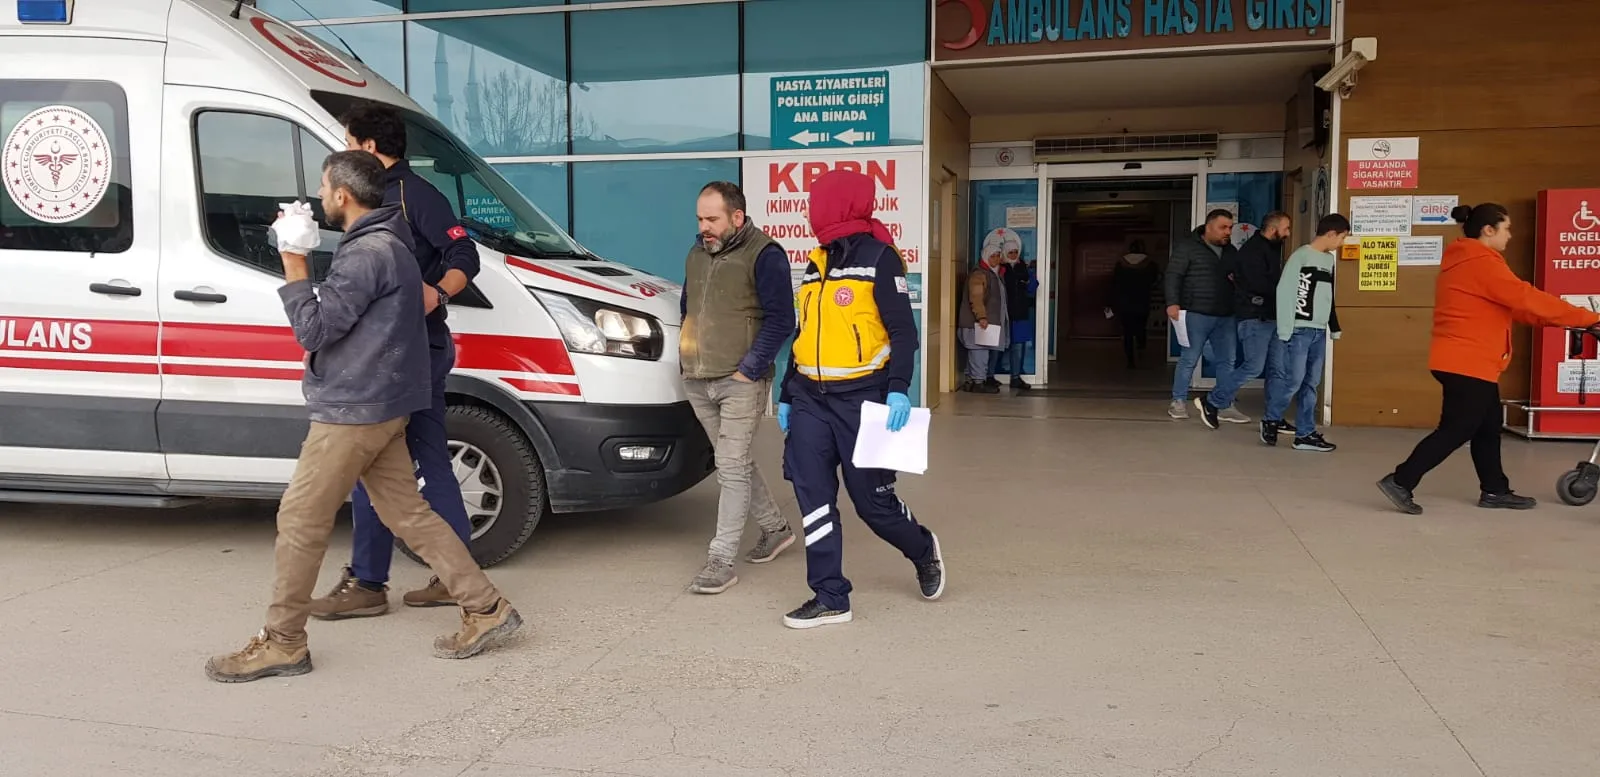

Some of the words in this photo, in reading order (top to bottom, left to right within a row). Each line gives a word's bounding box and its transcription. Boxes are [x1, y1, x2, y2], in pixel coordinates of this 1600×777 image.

[987, 0, 1132, 46] AMBULANS
[1144, 0, 1234, 37] HASTA
[775, 79, 812, 92] HASTA
[815, 75, 886, 90] ZİYARETLERİ
[777, 92, 845, 107] POLİKLİNİK
[847, 89, 884, 107] GİRİŞİ
[793, 111, 819, 123] ANA
[821, 108, 867, 122] BİNADA
[1359, 161, 1371, 169] BU
[1372, 161, 1407, 169] ALANDA
[768, 159, 896, 193] KBN
[1352, 169, 1384, 179] SİGARA
[1385, 169, 1413, 180] İÇMEK
[1361, 180, 1402, 188] YASAKTIR
[766, 196, 810, 217] (KİMYA
[1421, 203, 1449, 216] GİRİŞ
[1362, 241, 1376, 249] ALO
[1364, 253, 1394, 261] HASTANE
[1296, 272, 1313, 317] POWER
